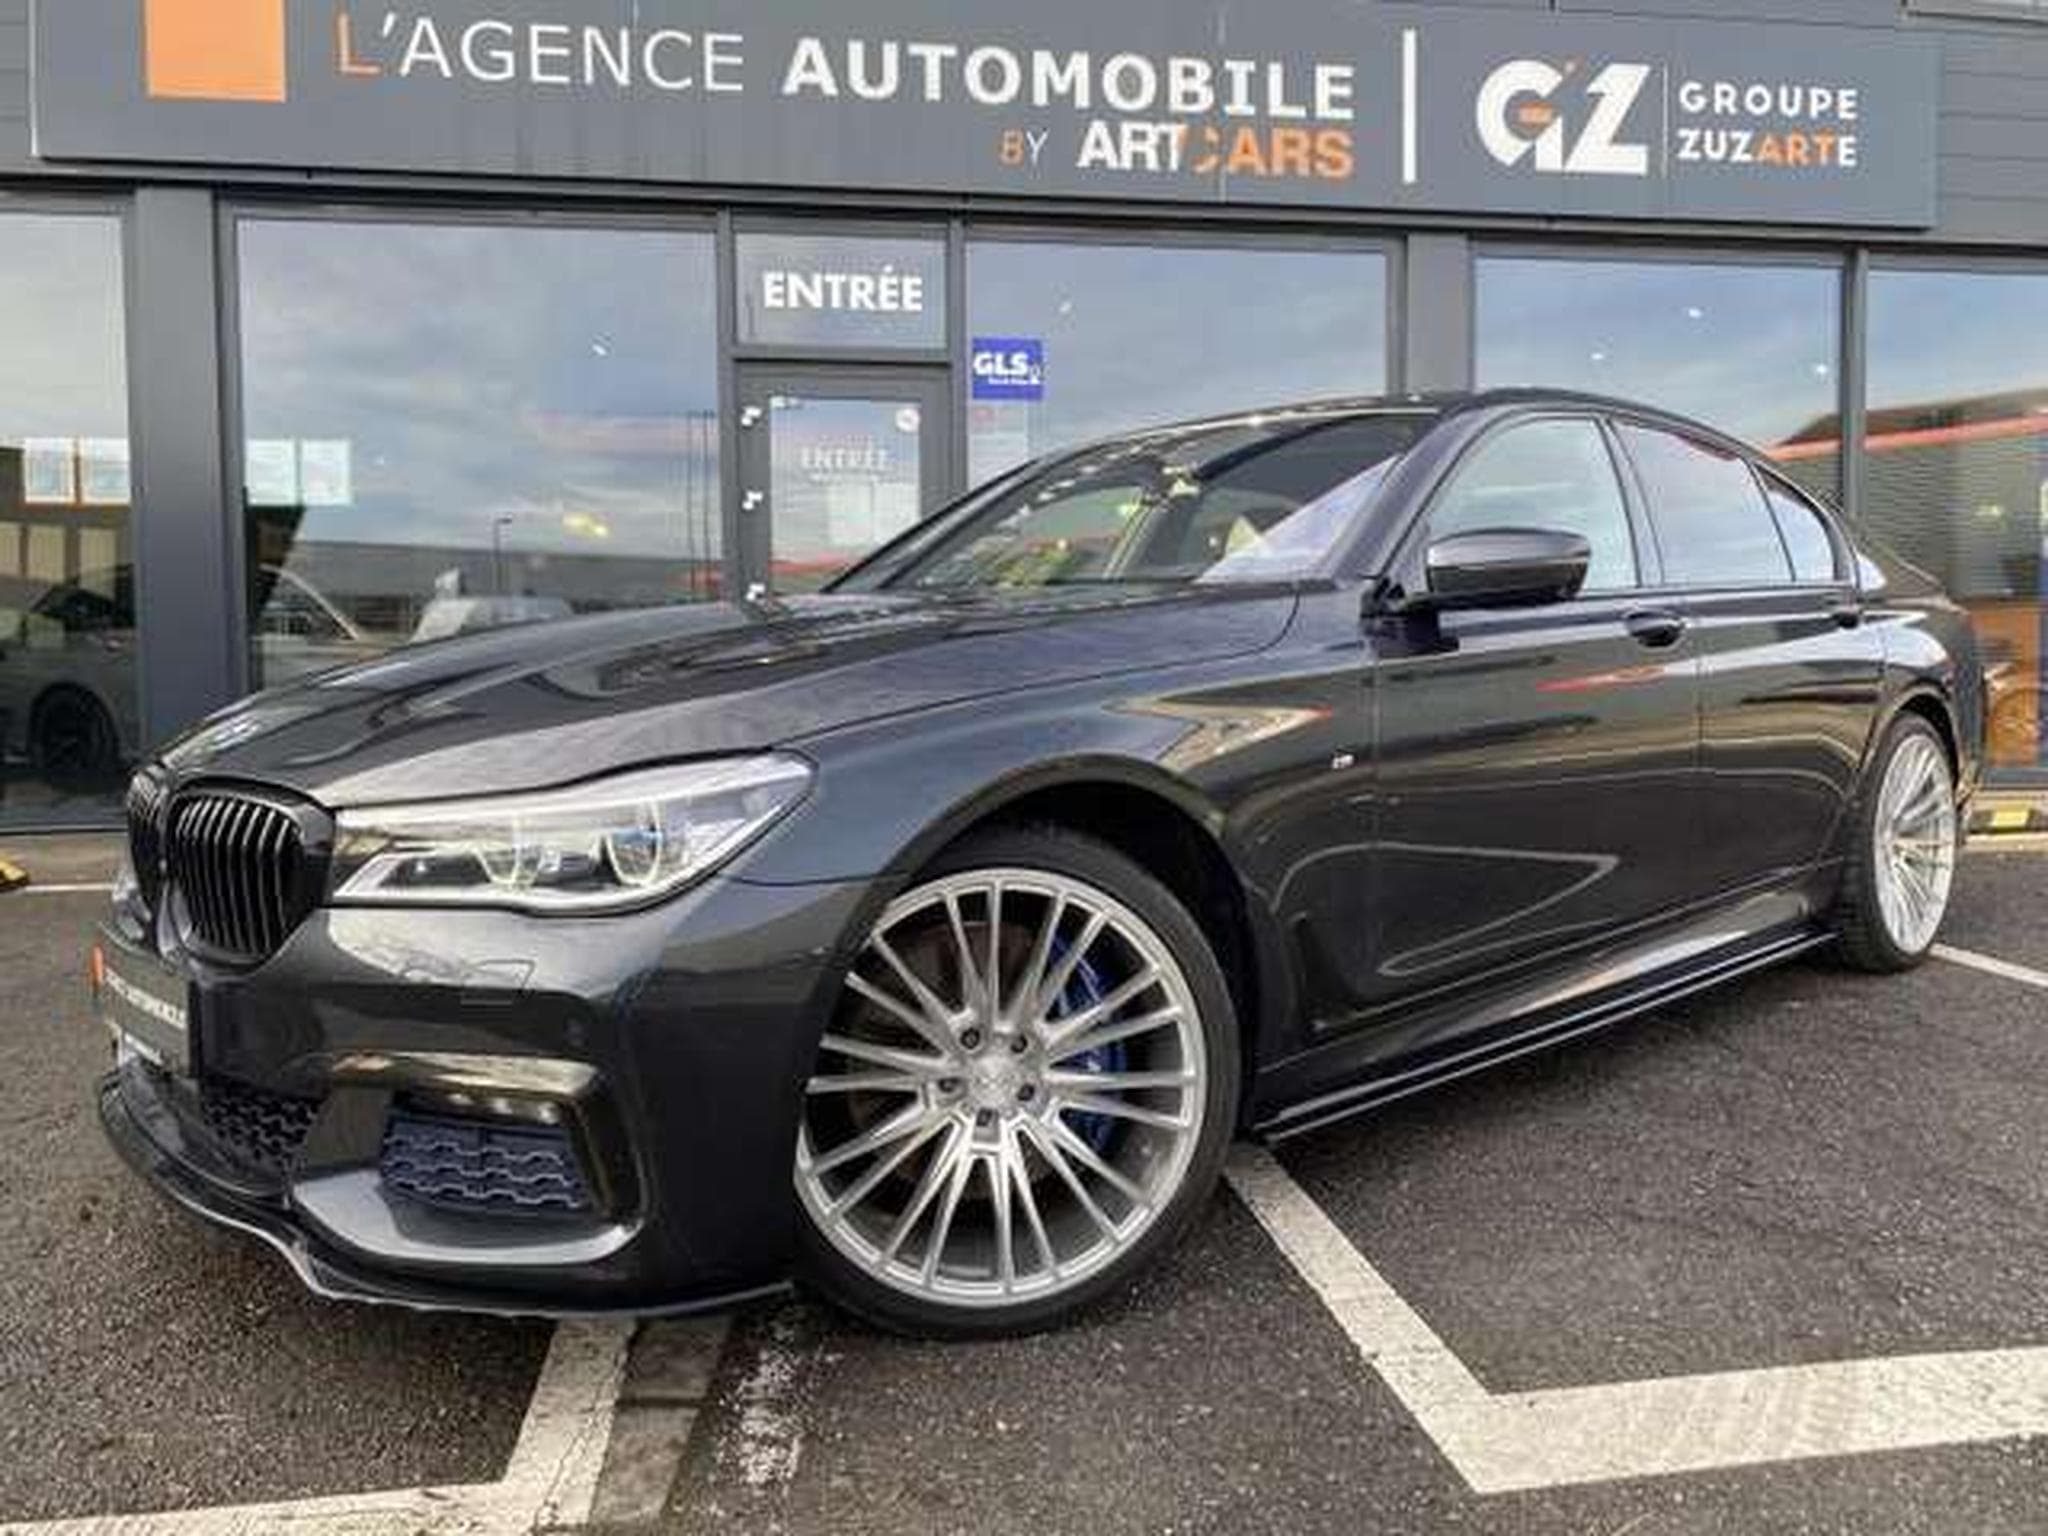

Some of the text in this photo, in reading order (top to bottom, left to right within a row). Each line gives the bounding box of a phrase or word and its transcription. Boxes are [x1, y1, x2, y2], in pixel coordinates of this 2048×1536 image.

[336, 12, 1356, 120] L'AGENCE AUTOMOBILE
[1678, 81, 1859, 120] GROUPE
[1000, 128, 1048, 166] BY
[1677, 127, 1859, 167] ZUZARTE
[761, 264, 924, 312] ENTRÉE
[973, 350, 1028, 376] GLS
